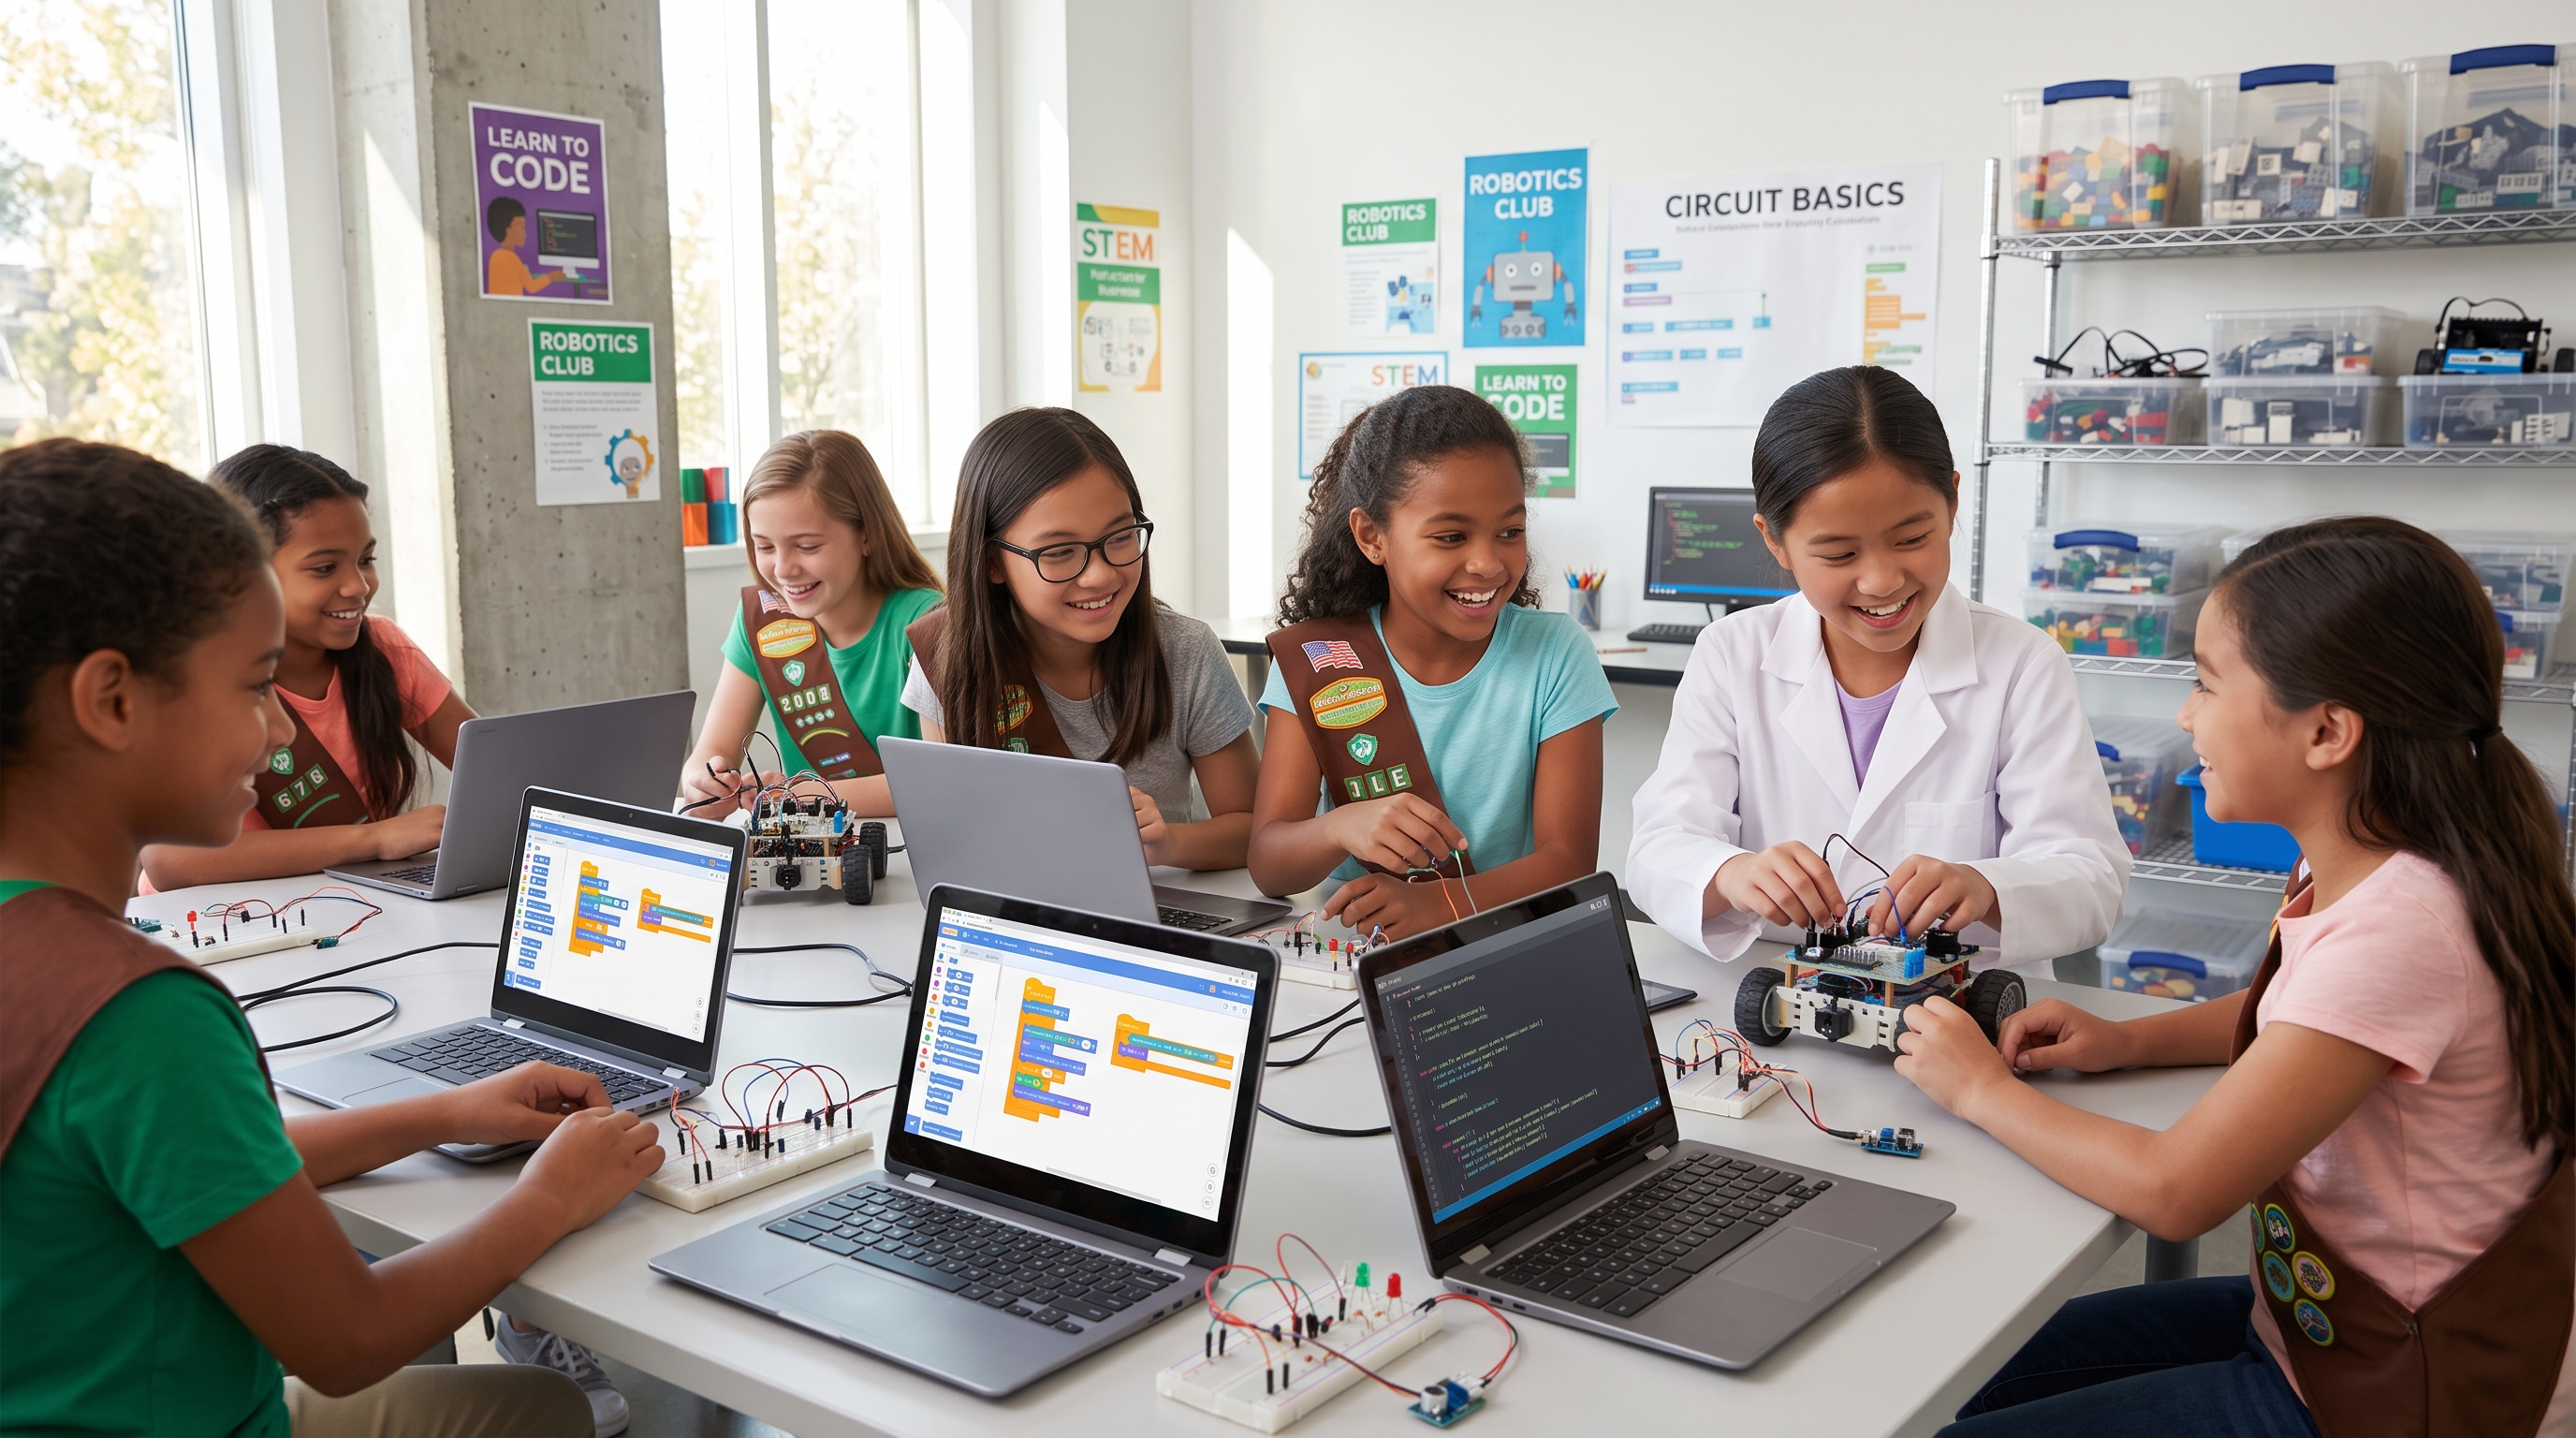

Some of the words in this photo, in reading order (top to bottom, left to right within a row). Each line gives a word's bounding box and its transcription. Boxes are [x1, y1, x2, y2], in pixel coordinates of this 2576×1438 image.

[487, 125, 557, 154] LEARN
[561, 135, 590, 158] TO
[490, 153, 592, 195] CODE
[1469, 167, 1583, 197] ROBOTICS
[1494, 196, 1554, 220] CLUB
[1665, 187, 1782, 218] CIRCUIT
[1793, 181, 1906, 213] BASICS
[1346, 203, 1427, 225] ROBOTICS
[1082, 227, 1154, 262] STEM
[1346, 224, 1390, 242] CLUB
[539, 331, 638, 354] ROBOTICS
[540, 356, 595, 376] CLUB
[1371, 364, 1439, 386] STEM
[1482, 374, 1541, 392] LEARN
[1542, 374, 1567, 391] TO
